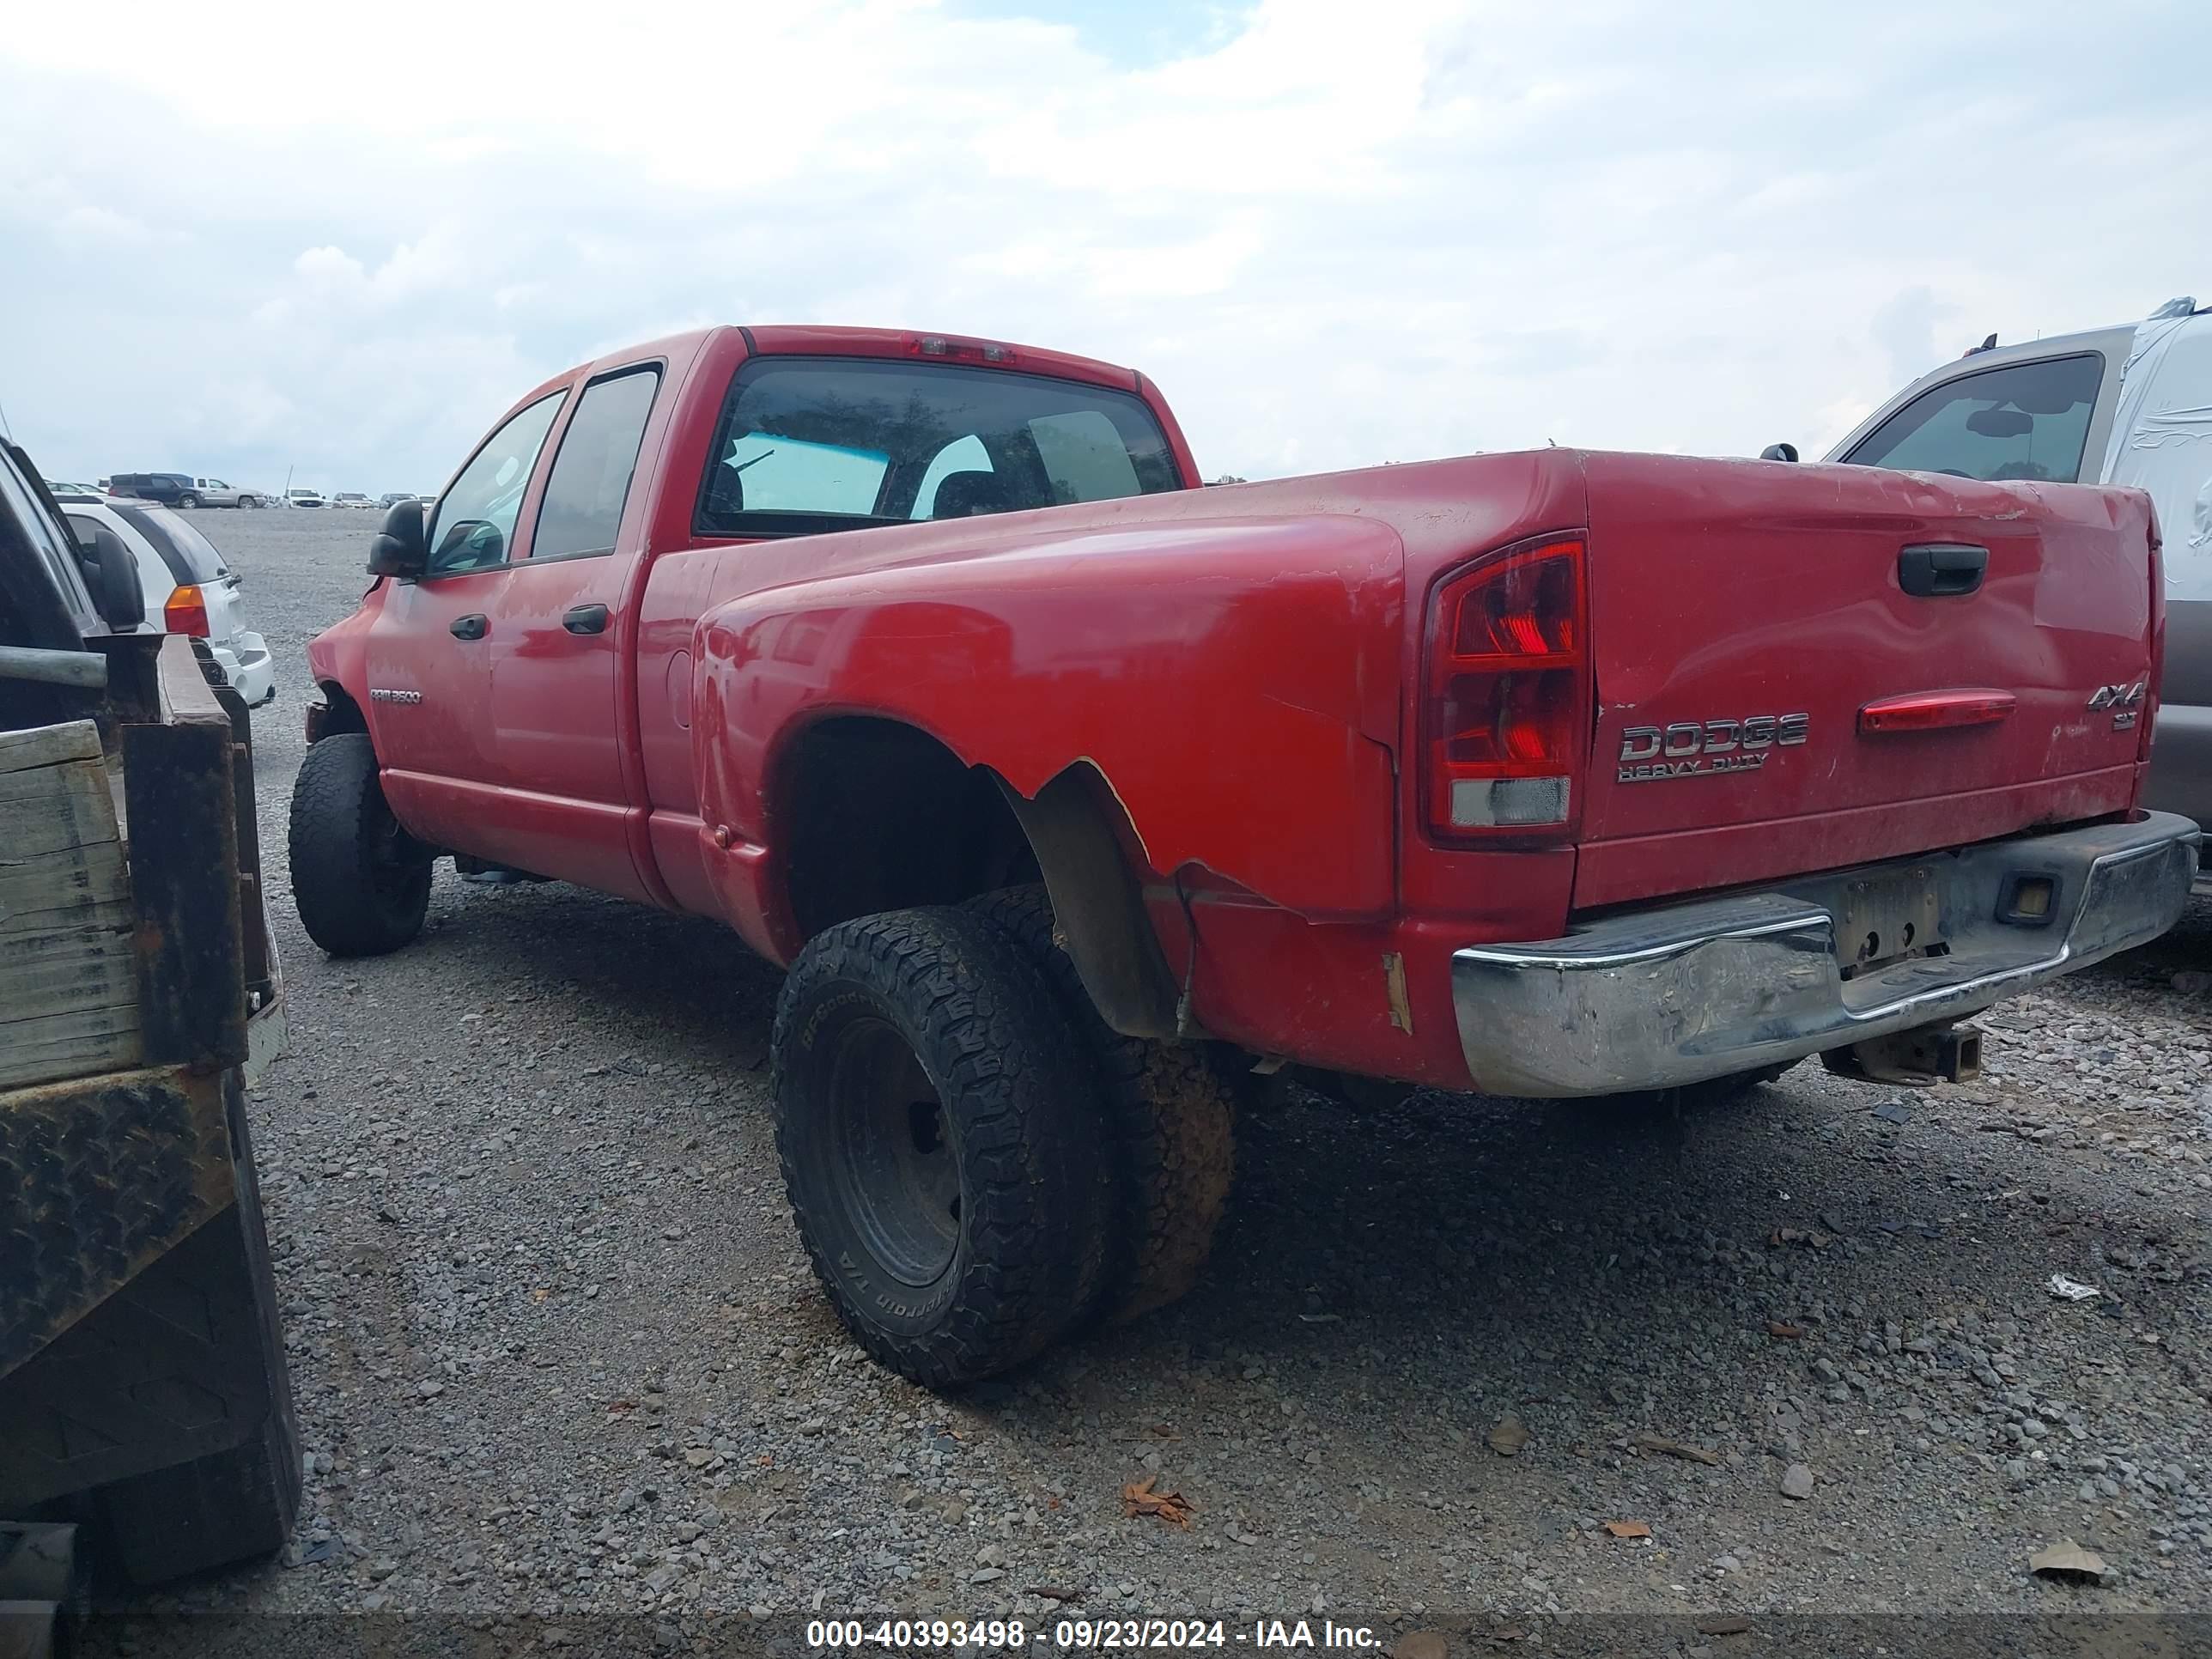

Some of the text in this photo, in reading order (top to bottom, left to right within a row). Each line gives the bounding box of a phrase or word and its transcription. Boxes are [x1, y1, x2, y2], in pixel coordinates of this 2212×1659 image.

[392, 690, 421, 704] 3500
[1620, 712, 1809, 762] DODGE
[1618, 752, 1769, 782] HEAVY DUTY
